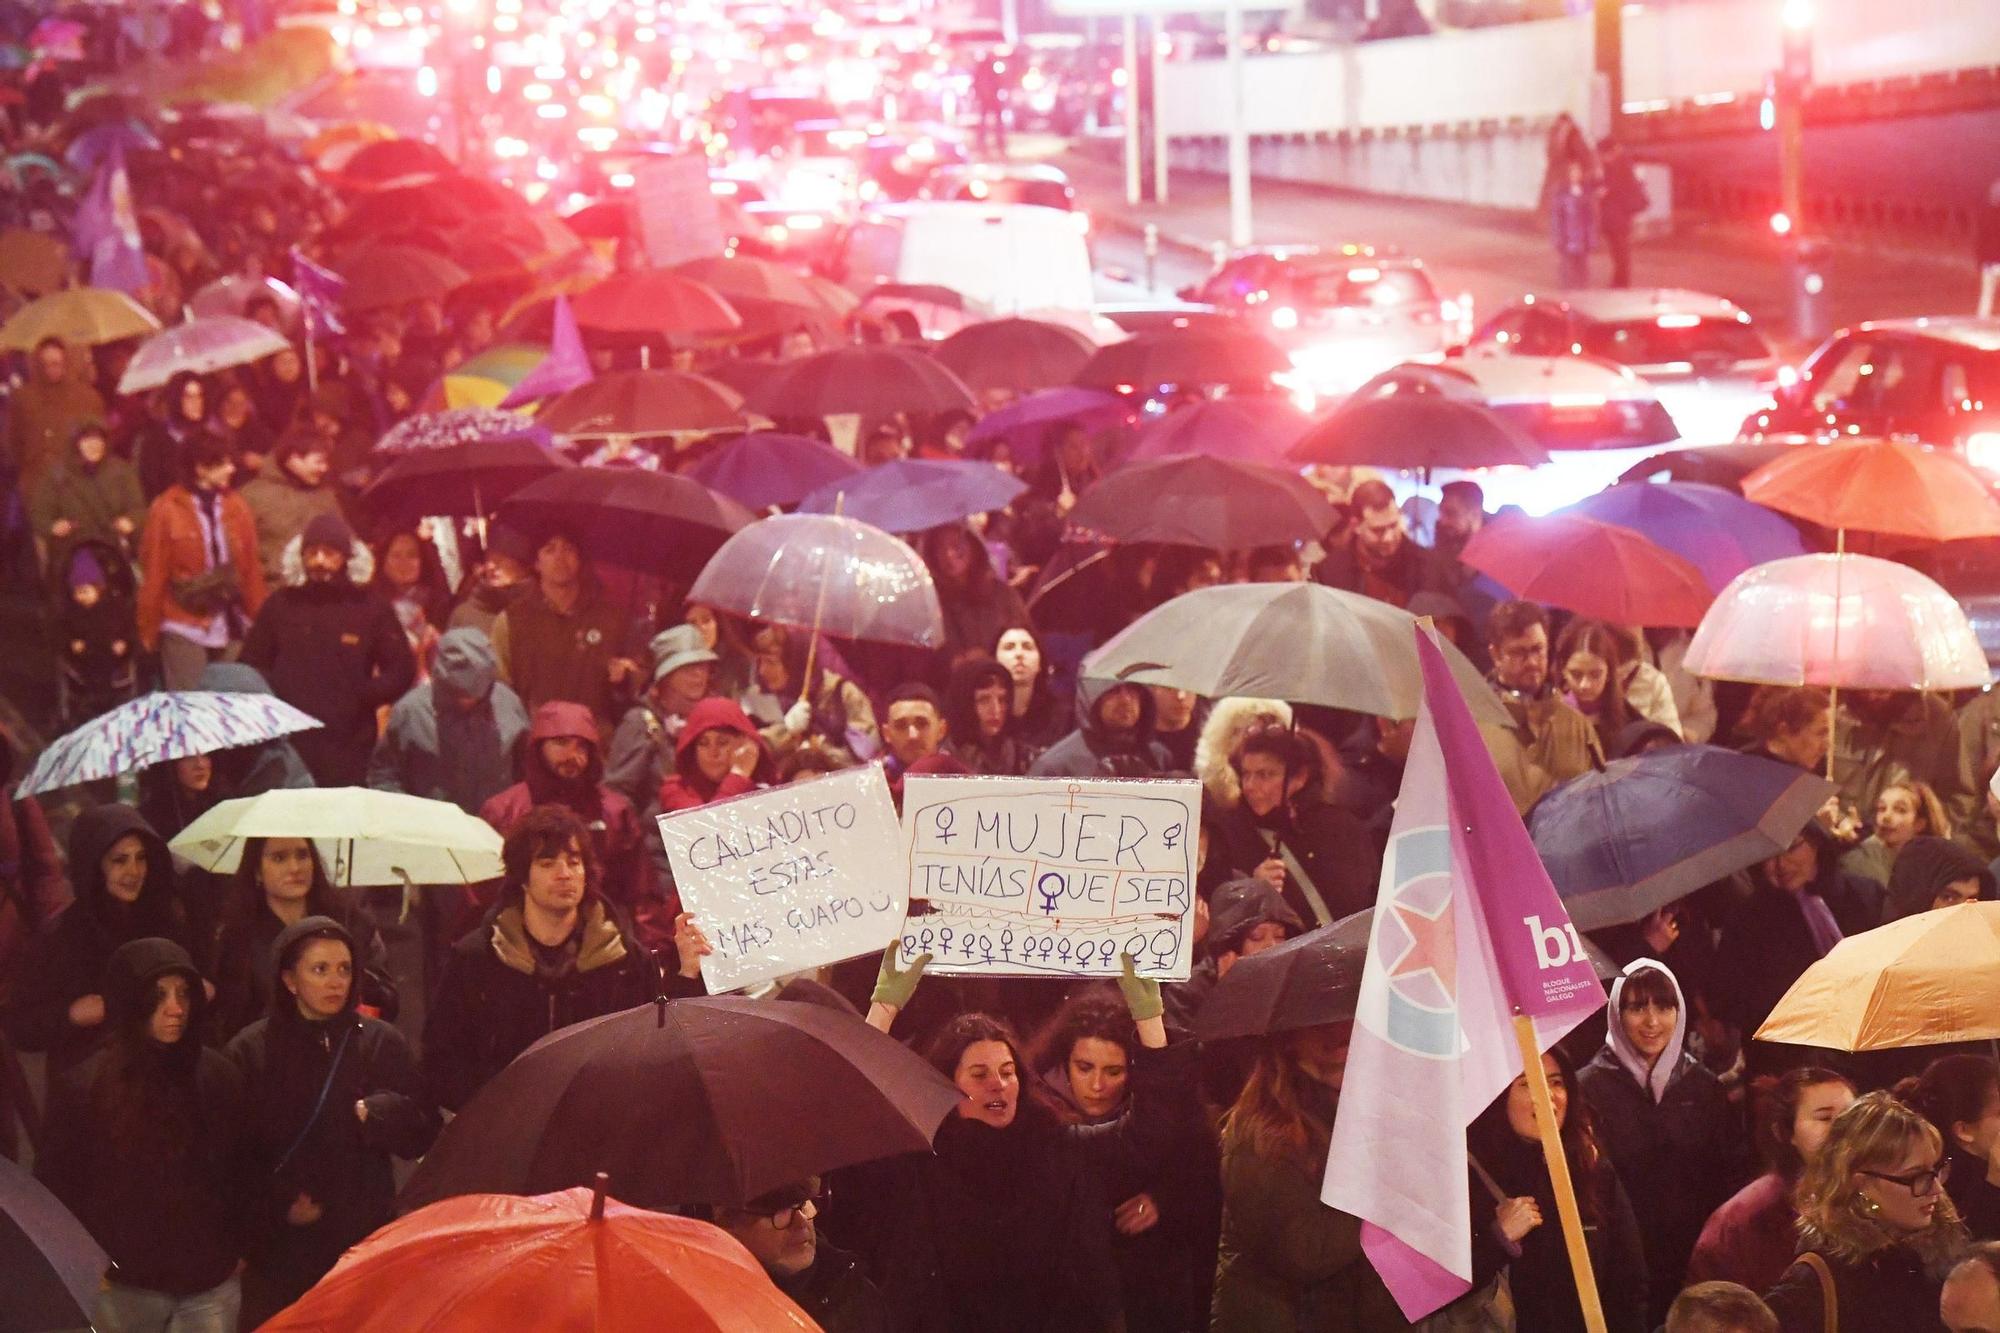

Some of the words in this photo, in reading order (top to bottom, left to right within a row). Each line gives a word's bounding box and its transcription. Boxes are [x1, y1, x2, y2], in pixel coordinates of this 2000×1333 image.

[689, 802, 856, 870] CALLADITO
[974, 810, 1148, 872] MUJER
[749, 850, 835, 896] ESTAS
[918, 855, 1027, 898] TENÍAS
[1038, 872, 1109, 915] QUE
[1118, 877, 1188, 910] SER
[717, 918, 773, 959] MAS
[786, 896, 864, 935] GUAPO
[1542, 977, 1571, 989] BLOQUE
[1544, 980, 1591, 996] NACIONALISTA
[1545, 991, 1574, 1003] GALEGO
